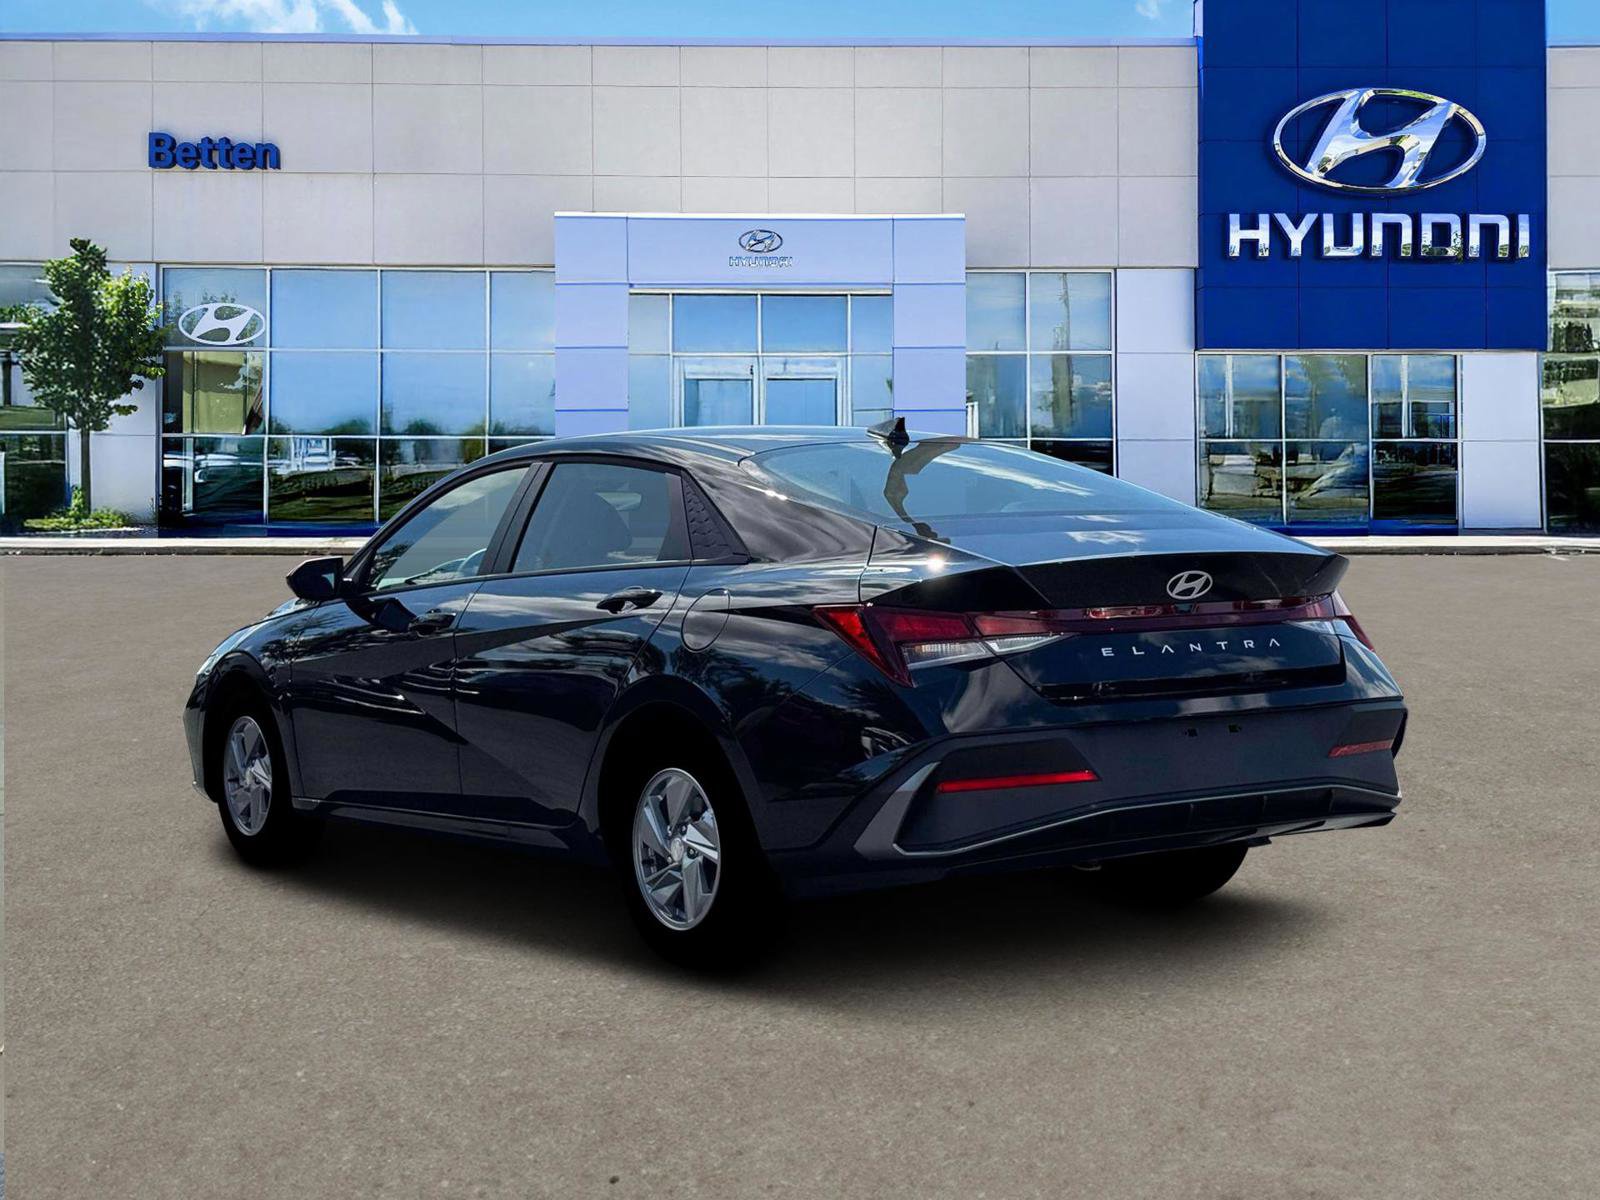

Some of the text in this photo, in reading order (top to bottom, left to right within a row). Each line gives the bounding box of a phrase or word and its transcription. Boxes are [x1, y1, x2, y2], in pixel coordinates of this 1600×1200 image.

[148, 132, 281, 170] Betten
[1228, 212, 1531, 258] HYUNDAI
[728, 255, 793, 268] HYUNDAI
[1101, 638, 1281, 657] ELANTRA
